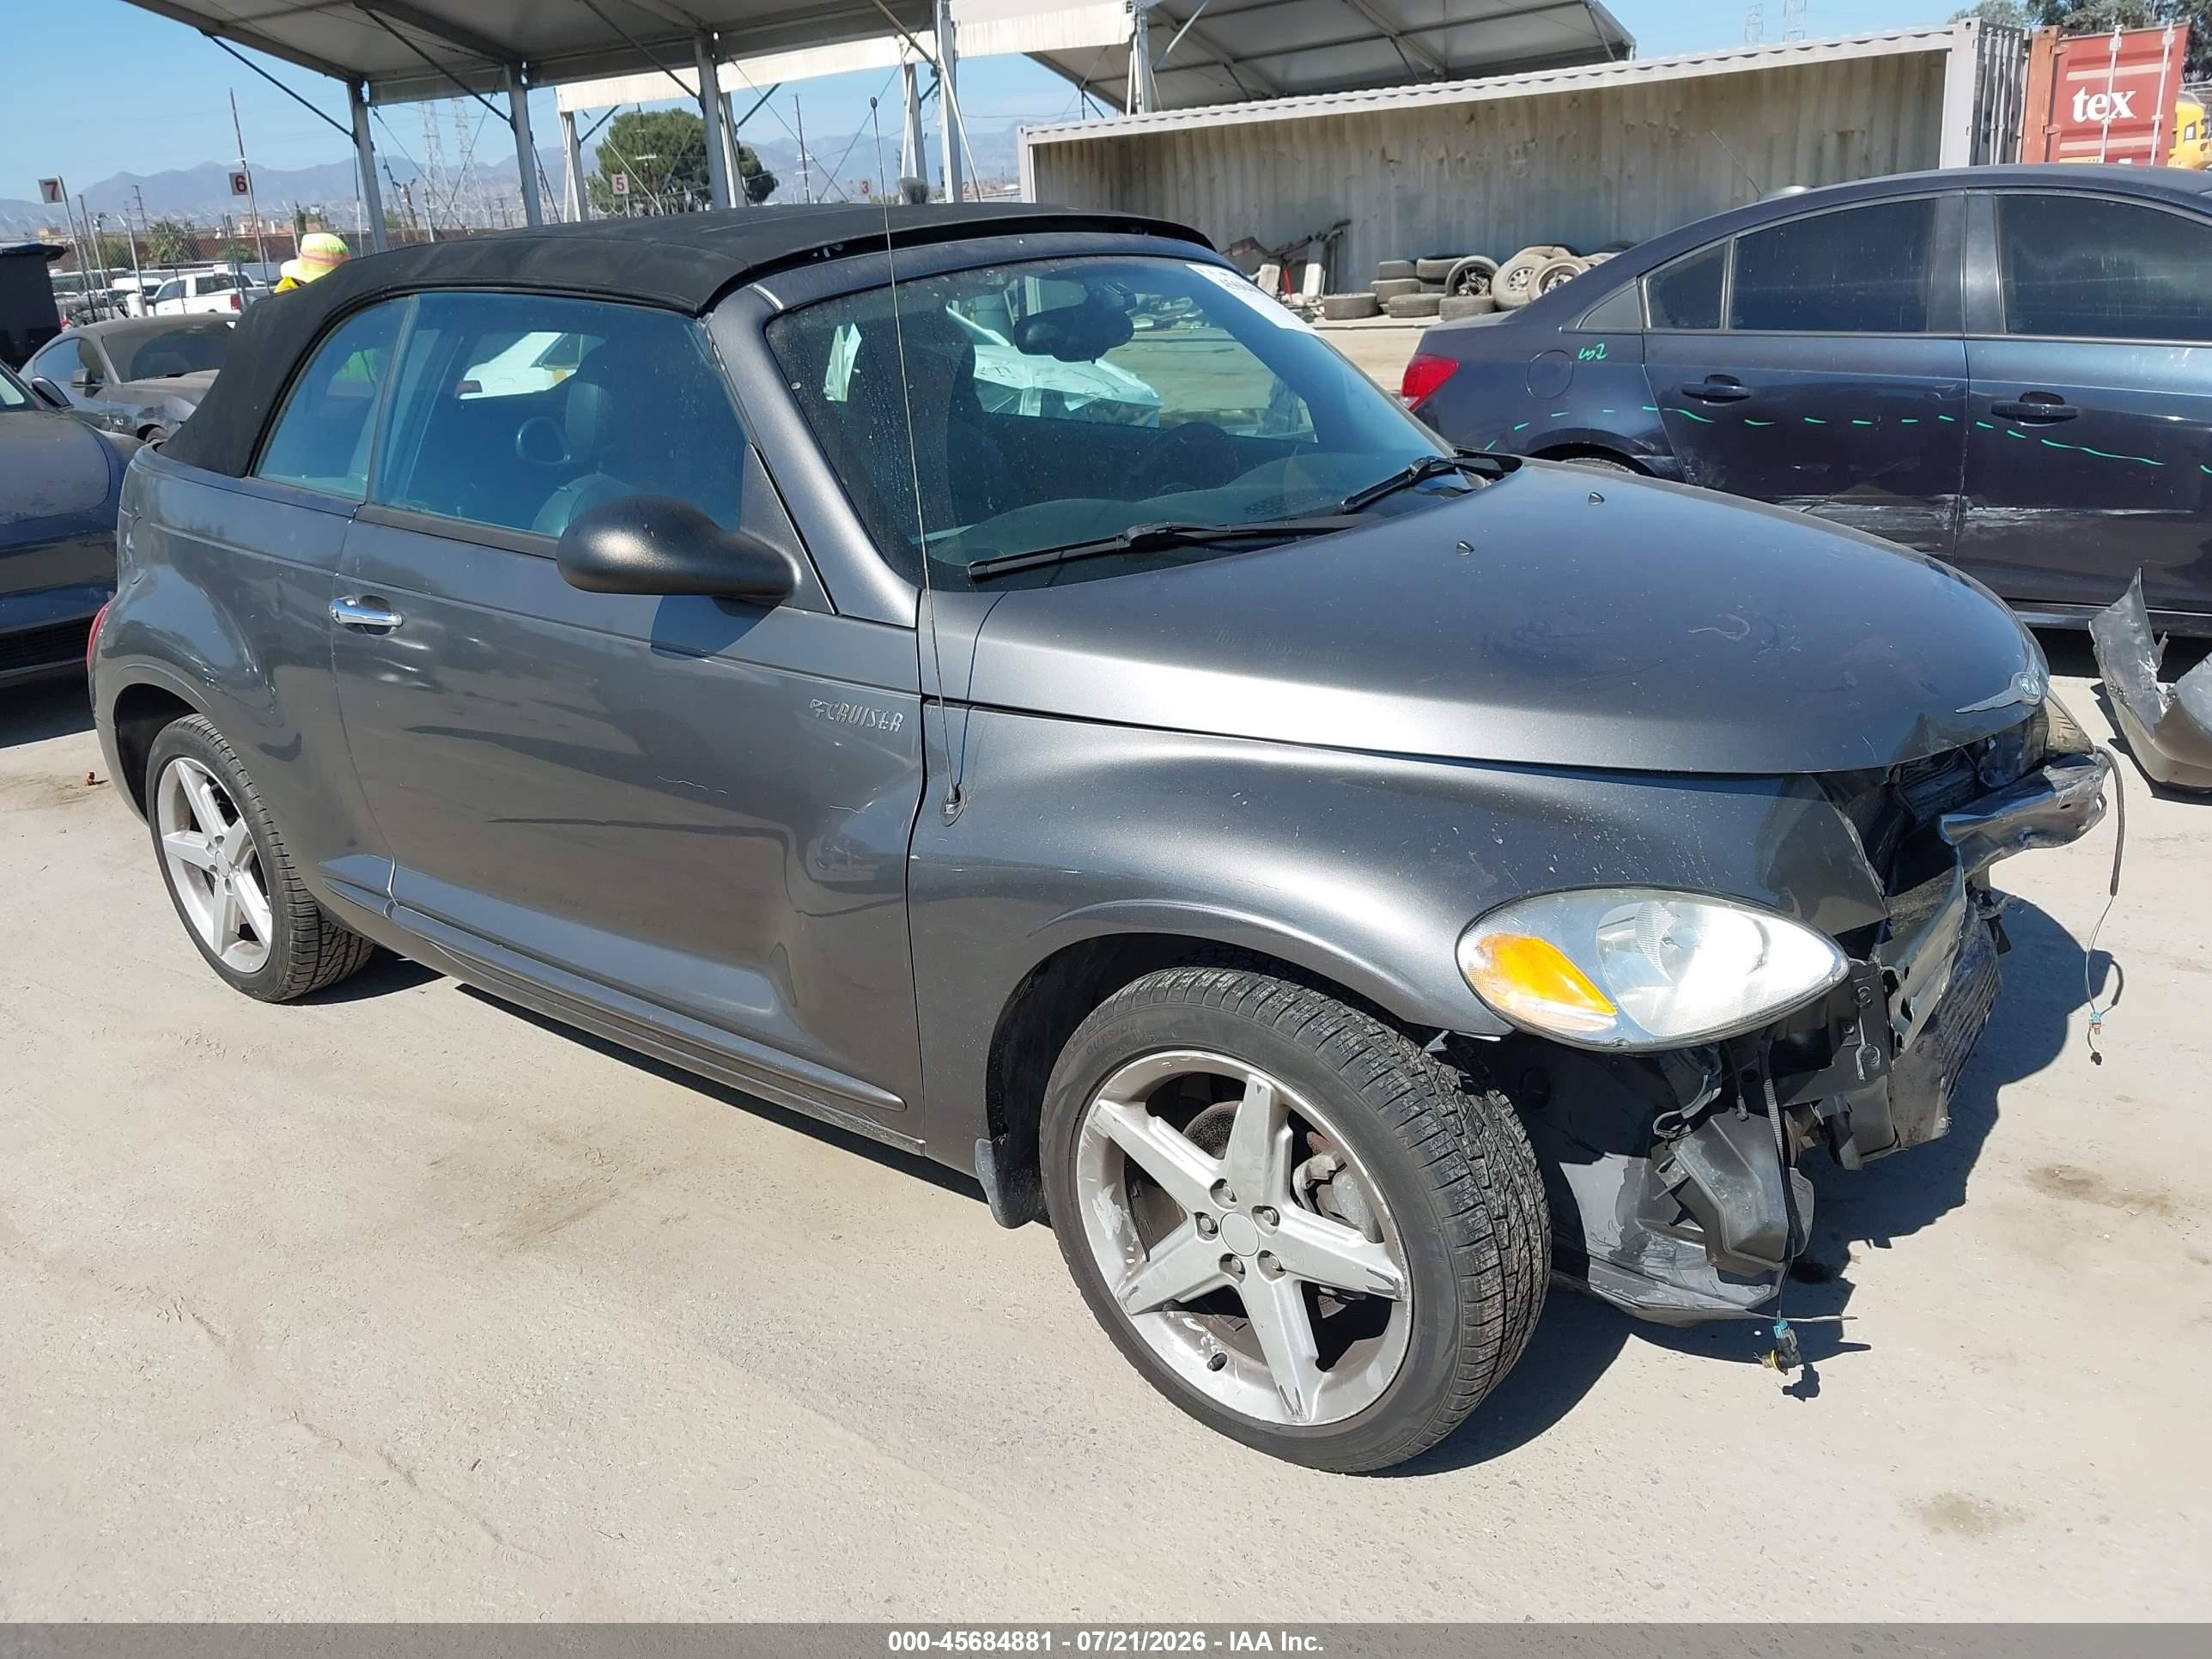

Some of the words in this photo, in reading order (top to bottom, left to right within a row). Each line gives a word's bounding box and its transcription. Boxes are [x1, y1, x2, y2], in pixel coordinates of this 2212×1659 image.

[2072, 86, 2136, 123] tex
[44, 181, 58, 200] 7
[234, 174, 247, 192] 6
[616, 177, 625, 191] 5
[861, 180, 869, 194] 3
[963, 181, 969, 194] 2
[826, 700, 904, 732] CRUISER
